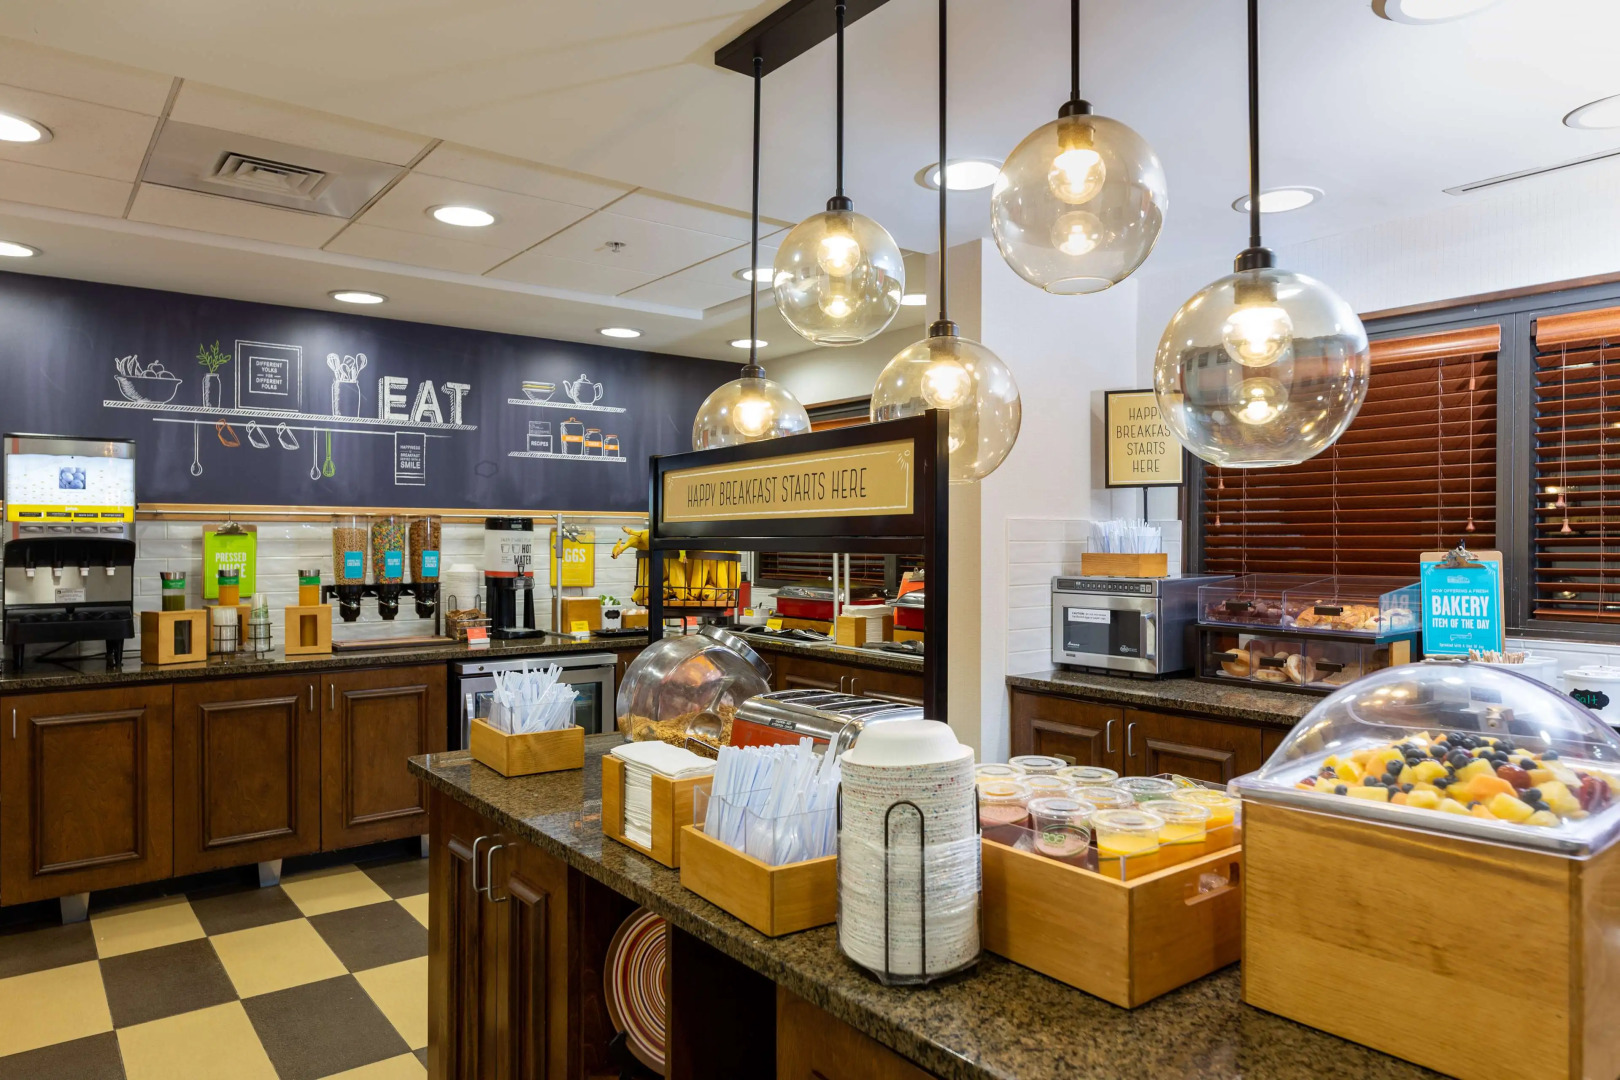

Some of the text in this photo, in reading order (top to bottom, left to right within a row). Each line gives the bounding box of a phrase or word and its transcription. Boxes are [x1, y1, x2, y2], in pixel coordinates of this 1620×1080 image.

[256, 360, 283, 368] DIFFERENT
[256, 377, 282, 385] DIFFERENT
[378, 375, 471, 425] EAT
[1129, 406, 1162, 421] HAPPY
[1116, 424, 1171, 439] BREAKFAS
[1127, 441, 1166, 456] STARTS
[400, 460, 421, 469] SMILE
[1132, 459, 1160, 473] HERE
[687, 467, 867, 508] HAPPY BREAKFAST STARTS HERE
[521, 543, 532, 554] HOT
[562, 547, 586, 563] GGS
[215, 552, 247, 562] PRESSED
[513, 554, 532, 565] WATER
[1431, 595, 1490, 617] BAKERY
[1432, 618, 1490, 630] ITEM OF THE DAY
[1574, 693, 1598, 705] Salt
